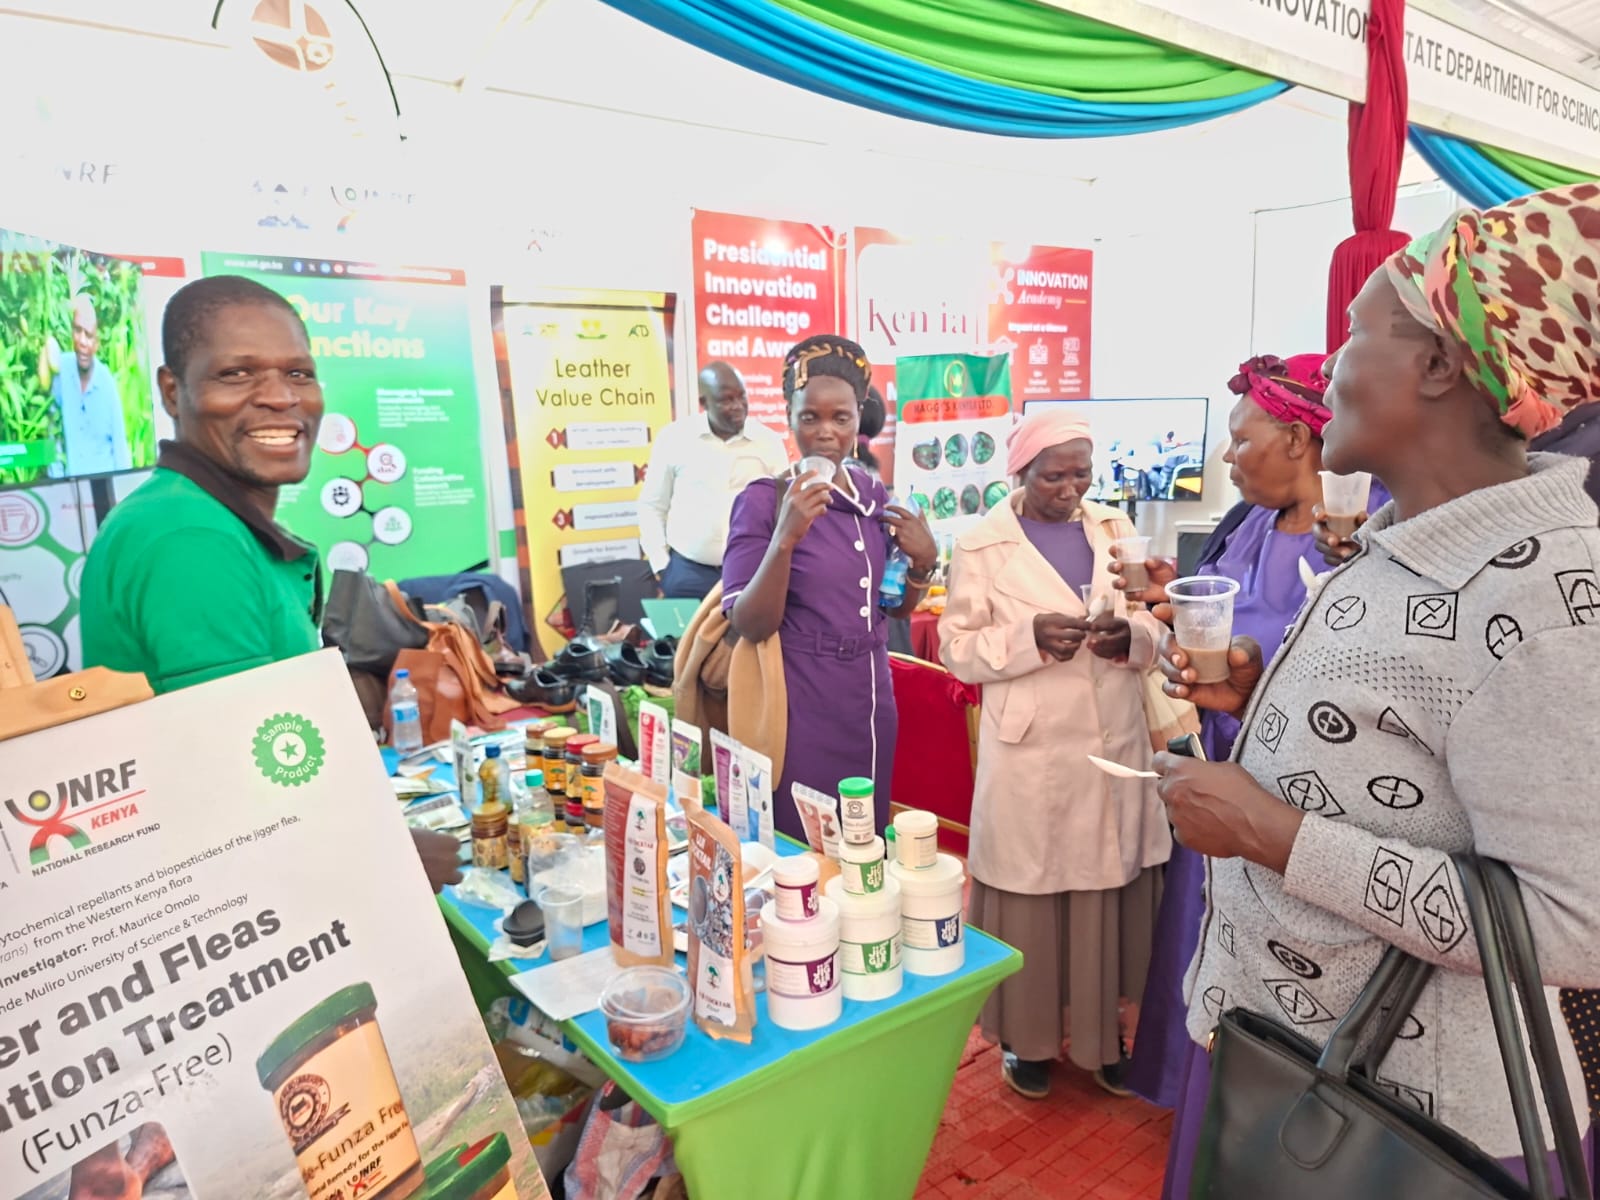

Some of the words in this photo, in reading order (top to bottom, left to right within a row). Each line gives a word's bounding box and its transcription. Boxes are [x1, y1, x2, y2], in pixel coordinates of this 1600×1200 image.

[1405, 30, 1442, 72] TATE
[1446, 47, 1535, 106] DEPARTMENT
[1537, 84, 1558, 117] FOR
[1562, 95, 1600, 132] SCIENC
[703, 238, 828, 271] Presidential
[704, 271, 817, 300] Innovation
[1017, 269, 1088, 290] INNOVATION
[286, 294, 345, 324] Our
[353, 297, 412, 333] Key
[1017, 289, 1063, 309] Academy
[705, 303, 811, 335] Challenge
[310, 331, 425, 359] nctions
[707, 336, 749, 357] and
[555, 359, 632, 378] Leather
[536, 389, 593, 407] Value
[599, 388, 656, 406] Chain
[262, 720, 302, 743] Sample
[69, 758, 137, 808] NRF
[275, 756, 317, 778] Product
[91, 803, 139, 830] KENYA
[32, 853, 83, 877] NATIONAL
[84, 832, 135, 857] RESEARCH
[136, 823, 161, 838] FUND
[0, 906, 75, 947] ytochemical
[77, 883, 132, 913] repellants
[134, 872, 156, 890] and
[156, 846, 224, 880] biopesticides
[224, 839, 235, 850] of
[236, 833, 253, 848] the
[253, 822, 280, 842] jigger
[281, 815, 302, 829] flea,
[33, 930, 64, 948] from
[65, 919, 86, 935] the
[88, 900, 134, 926] Western
[135, 885, 168, 908] Kenya
[169, 874, 193, 891] flora
[91, 929, 119, 947] Prof.
[119, 910, 163, 935] Maurice
[164, 893, 200, 914] Omolo
[0, 998, 23, 1015] nde
[25, 978, 65, 1002] Muliro
[67, 950, 125, 982] University
[127, 942, 139, 955] of
[140, 926, 181, 949] Science
[183, 919, 191, 929] &
[190, 893, 249, 925] Technology
[0, 1019, 42, 1069] er
[57, 960, 155, 1036] and
[160, 908, 281, 984] Fleas
[123, 919, 352, 1057] Treatment
[21, 1032, 233, 1174] (Funza-Free)
[358, 1150, 371, 1163] for
[371, 1140, 384, 1152] the
